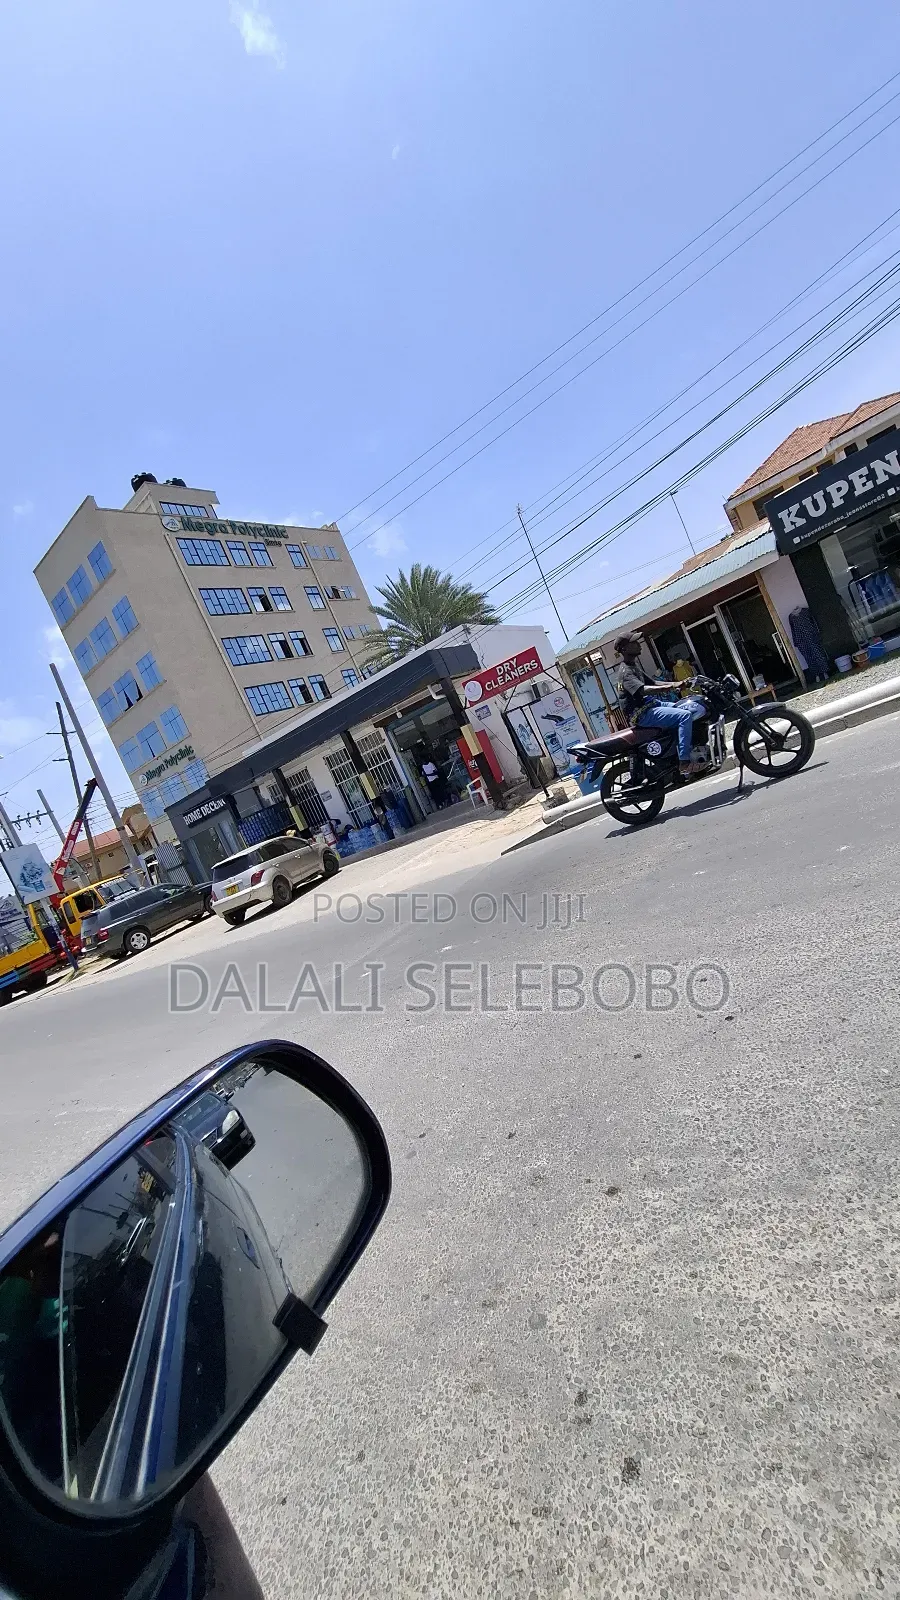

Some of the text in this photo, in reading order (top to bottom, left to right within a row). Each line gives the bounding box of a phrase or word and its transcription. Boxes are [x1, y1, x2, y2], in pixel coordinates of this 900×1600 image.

[778, 450, 900, 534] KUPEN
[180, 517, 289, 539] Megra Polyclinic
[485, 659, 539, 691] CLEANERS
[496, 657, 517, 676] DRY
[182, 808, 203, 826] HOME
